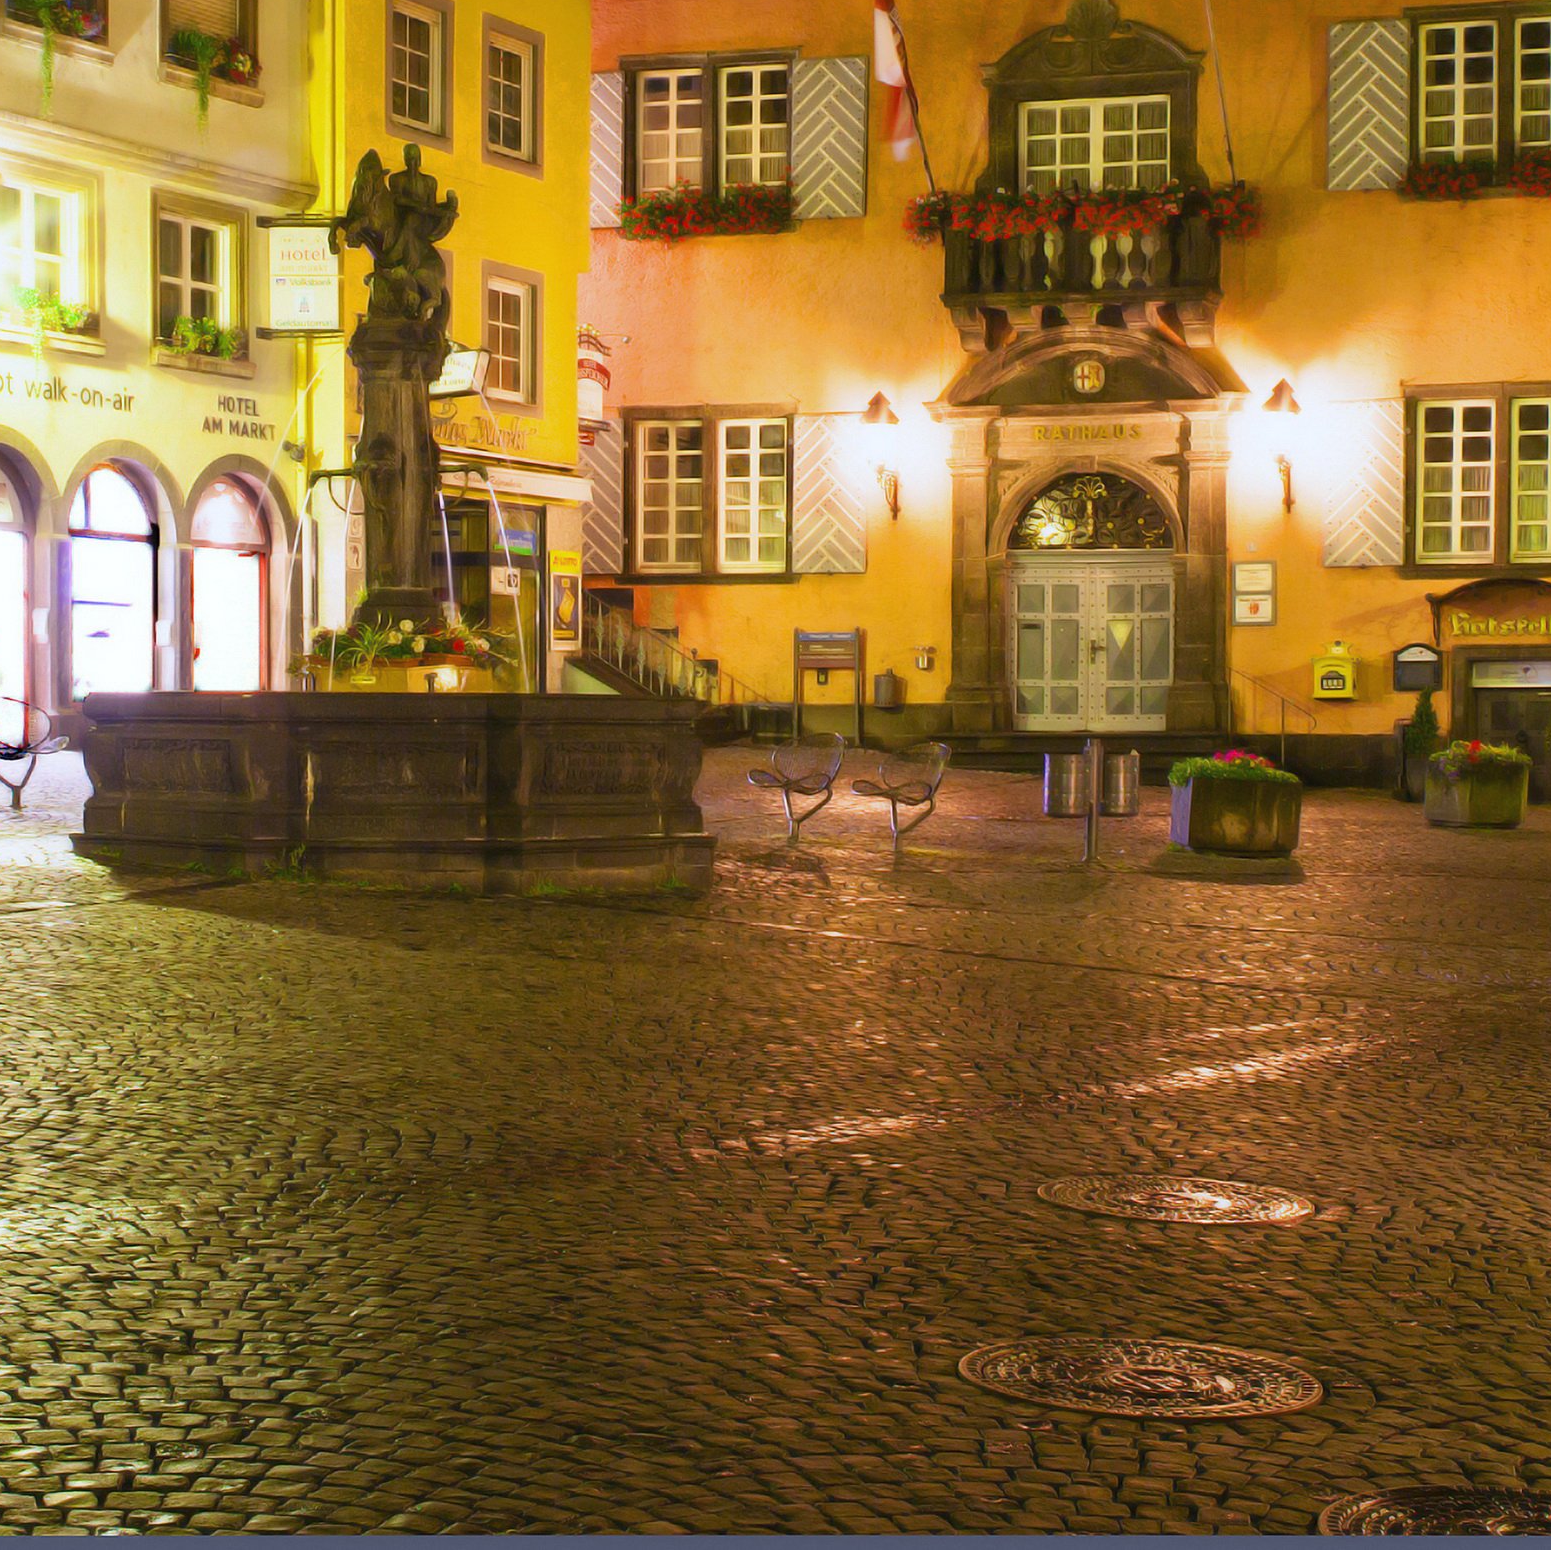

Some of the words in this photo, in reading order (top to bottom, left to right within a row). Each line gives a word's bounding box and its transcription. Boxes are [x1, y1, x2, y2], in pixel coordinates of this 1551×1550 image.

[216, 394, 260, 417] HOTEL
[201, 415, 224, 435] AM
[228, 418, 277, 442] MARKT
[1033, 423, 1144, 441] RATHAUS
